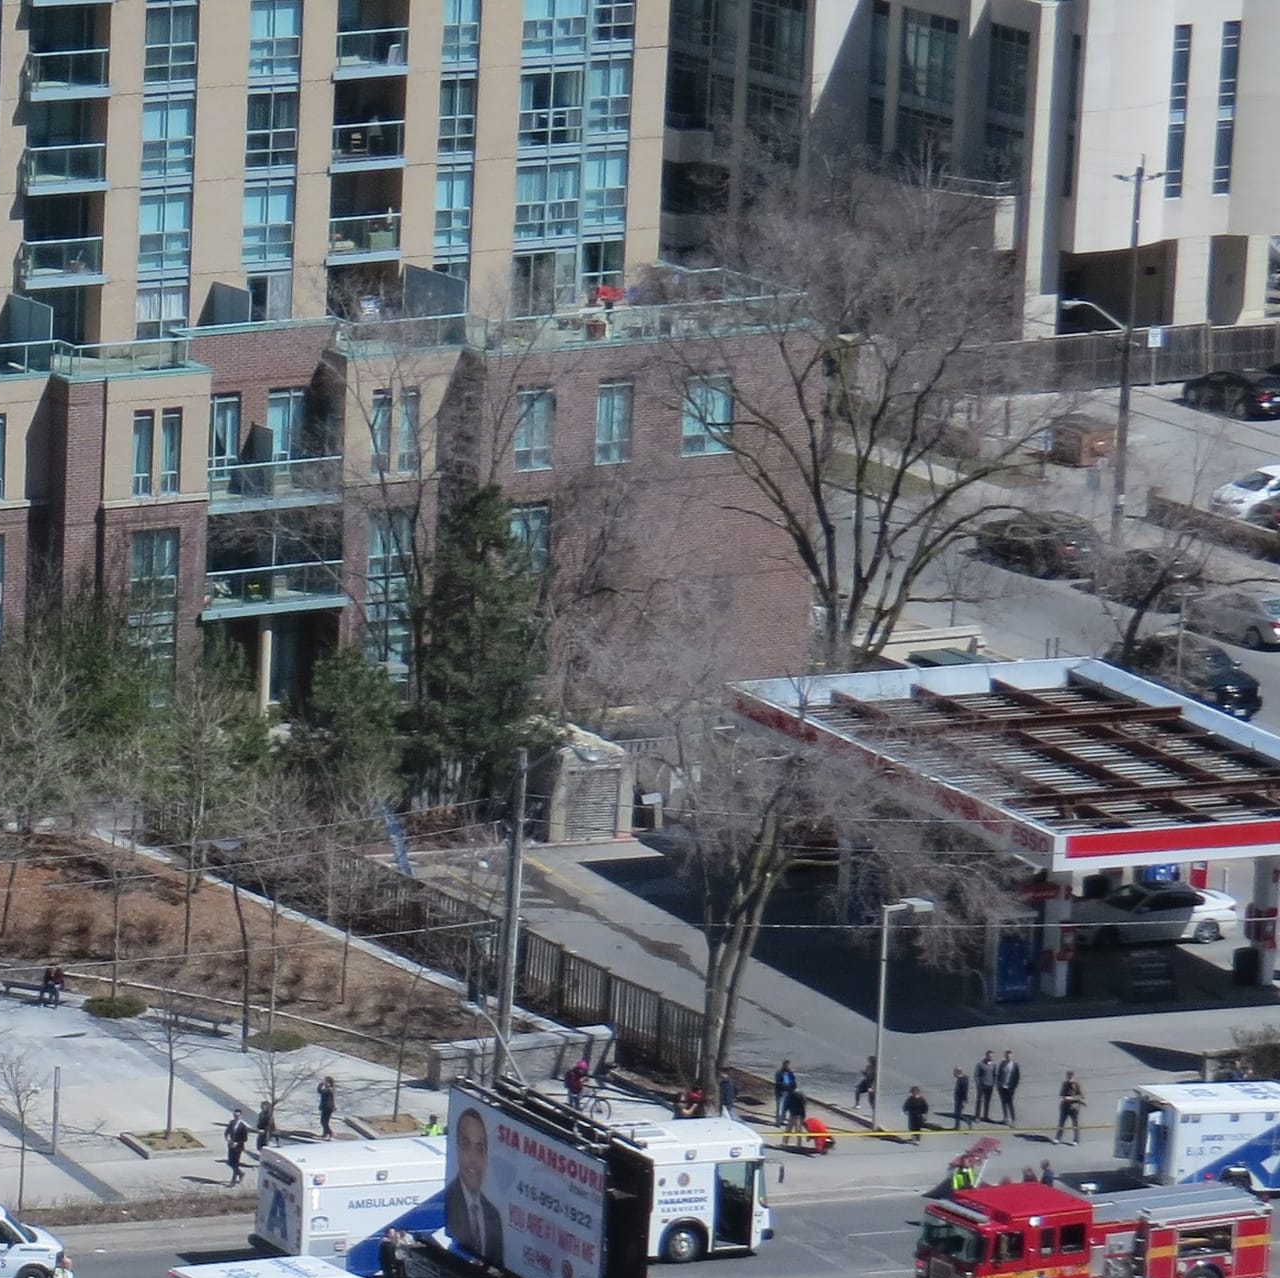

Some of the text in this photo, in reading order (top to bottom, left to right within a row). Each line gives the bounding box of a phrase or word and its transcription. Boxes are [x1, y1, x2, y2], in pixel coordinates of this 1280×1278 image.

[497, 1124, 604, 1193] SIA MANSOURI
[661, 1188, 706, 1197] TORONTO
[348, 1196, 420, 1210] AMBULANCE
[658, 1196, 708, 1206] PARAMEDIC
